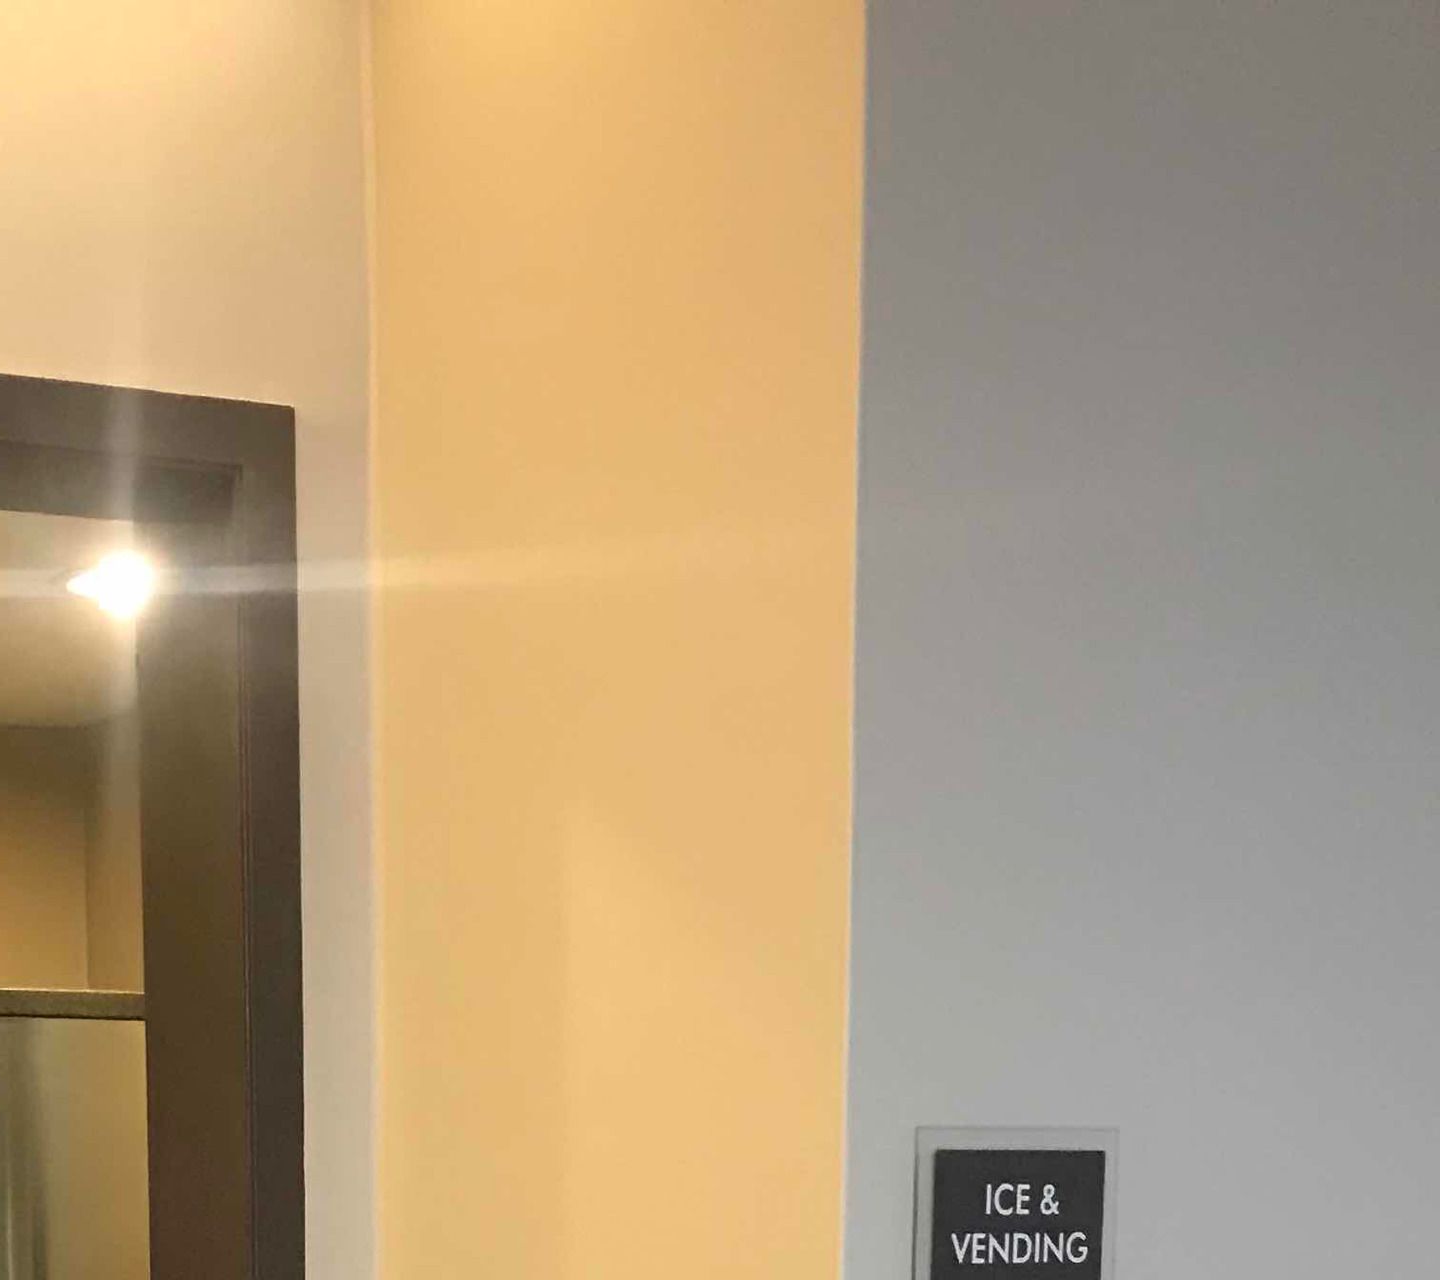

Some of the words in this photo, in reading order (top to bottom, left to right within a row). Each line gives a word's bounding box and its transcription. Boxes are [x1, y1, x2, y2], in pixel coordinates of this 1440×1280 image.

[985, 1183, 1031, 1216] ICE
[1040, 1184, 1059, 1215] &
[951, 1231, 1089, 1264] VENDING
